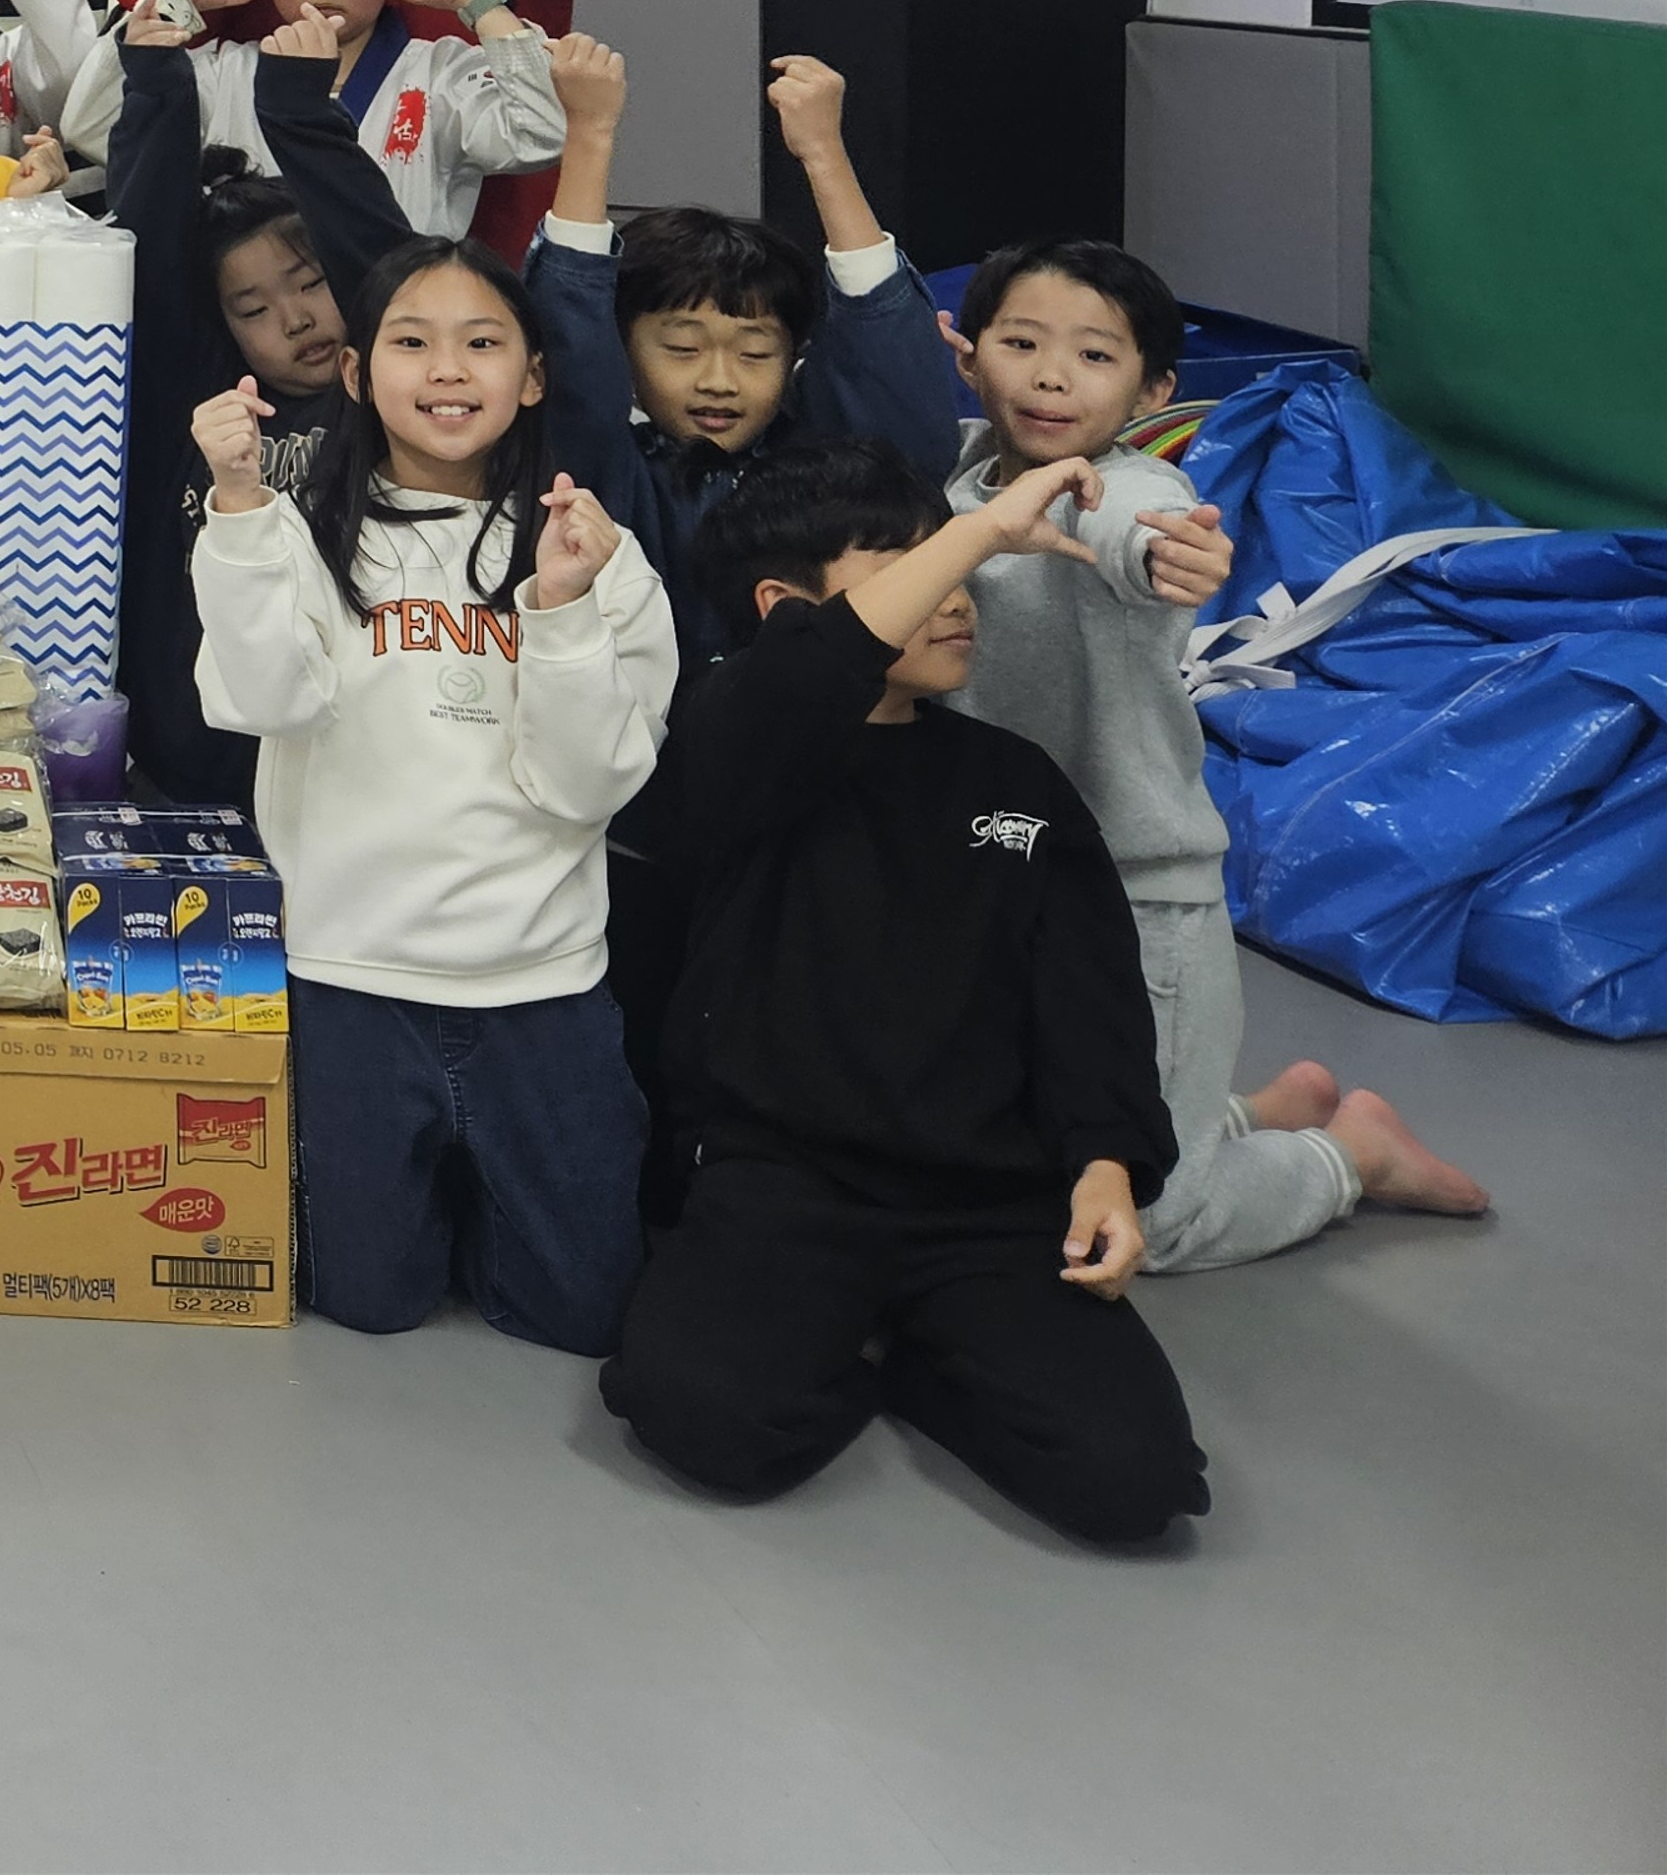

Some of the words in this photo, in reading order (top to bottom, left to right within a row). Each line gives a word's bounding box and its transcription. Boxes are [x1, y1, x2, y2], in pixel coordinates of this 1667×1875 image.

[361, 599, 523, 663] TENN
[430, 710, 448, 719] BEST
[78, 886, 92, 900] 10
[185, 889, 200, 903] 10
[103, 1047, 148, 1063] 0712
[12, 1137, 168, 1208] 진라면
[159, 1196, 215, 1225] 매운맛
[174, 1298, 202, 1312] 52
[210, 1299, 251, 1314] 228
